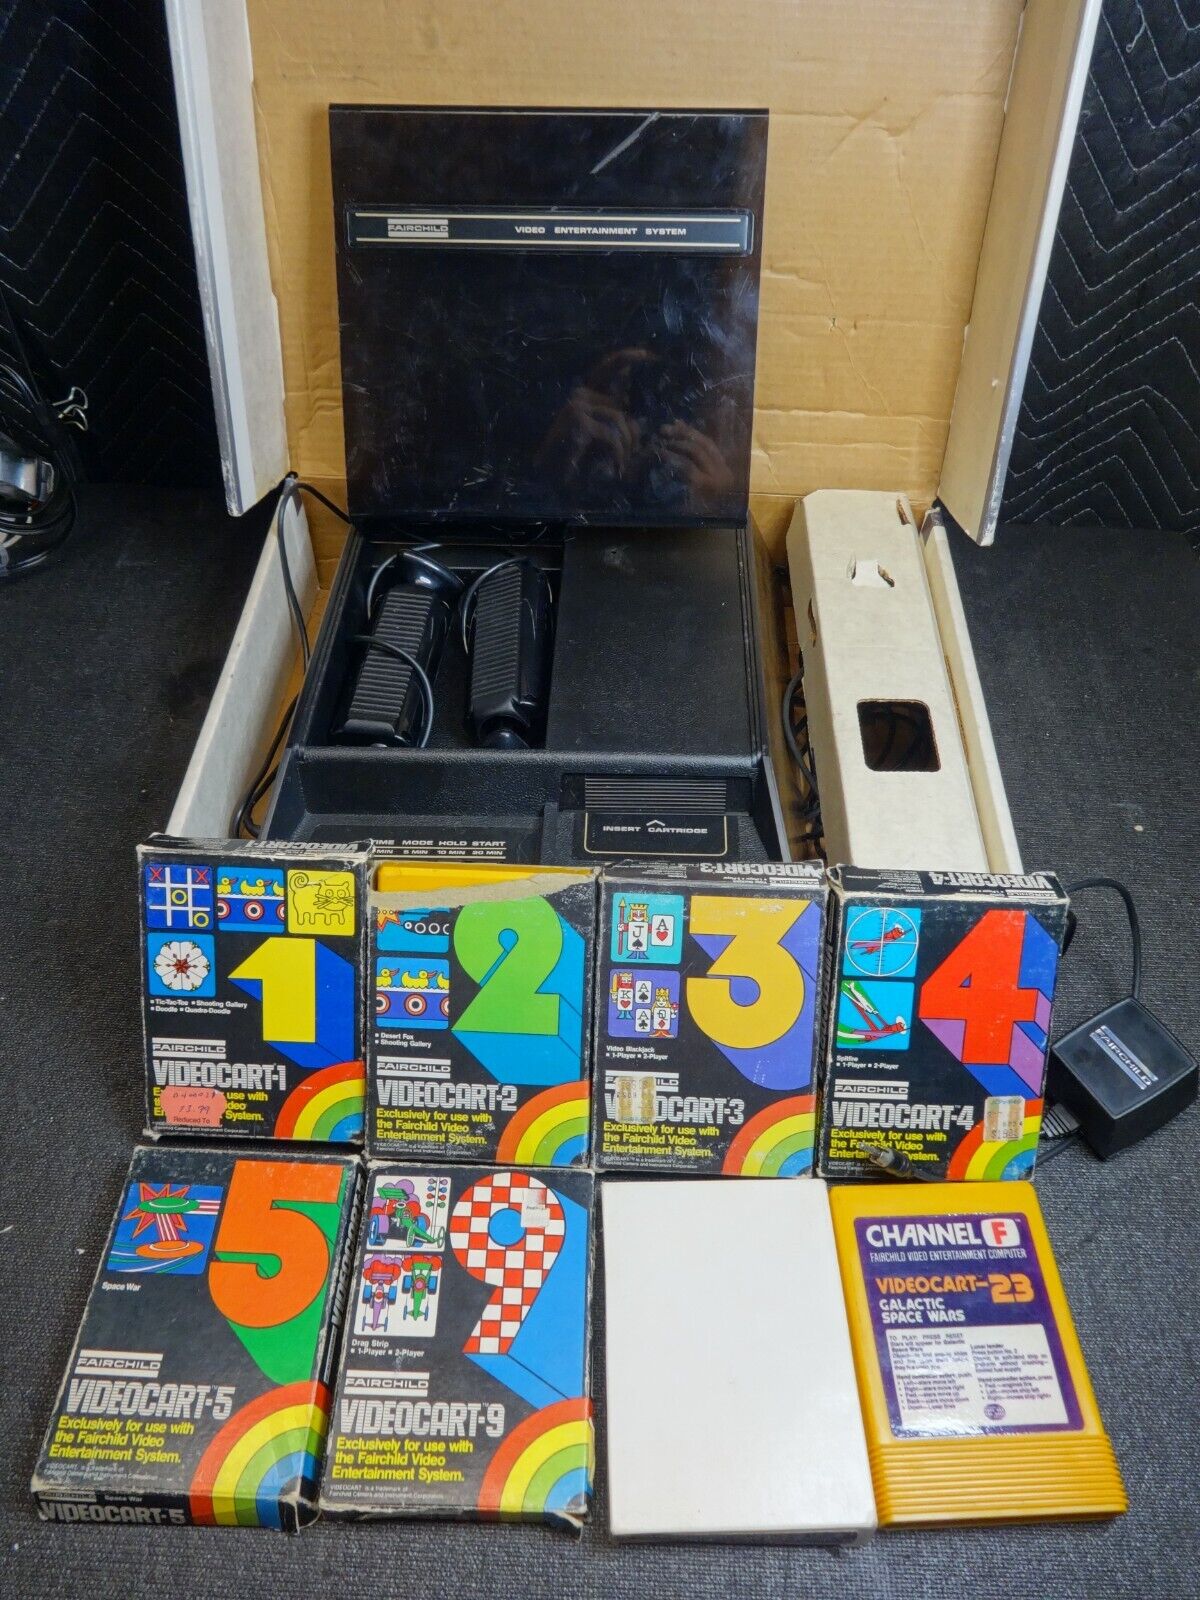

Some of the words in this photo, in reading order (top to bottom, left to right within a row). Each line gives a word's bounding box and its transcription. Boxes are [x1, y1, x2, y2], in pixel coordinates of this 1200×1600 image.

[514, 226, 546, 235] VIDEO
[554, 226, 638, 236] ENTERTAINMENT
[645, 228, 687, 236] SYSTEM
[648, 826, 708, 834] CARTRIDGE
[929, 870, 1053, 889] VIDEOCART-4
[656, 918, 669, 930] A
[632, 925, 645, 938] J
[451, 896, 563, 1036] 2
[687, 895, 813, 1050] 3
[227, 937, 315, 1043] 1
[637, 983, 649, 992] A
[919, 909, 1039, 1065] 4
[620, 990, 632, 1000] K
[196, 1000, 224, 1008] Shooting
[638, 1010, 649, 1020] A
[656, 1010, 668, 1020] Q
[380, 1040, 408, 1048] Shooting
[626, 1046, 655, 1054] Blackjack
[612, 1052, 636, 1060] 1-Player
[643, 1052, 668, 1060] 2-Player
[836, 1054, 858, 1062] Spitfire
[1094, 1028, 1152, 1086] FAIRCHILD
[874, 1062, 899, 1070] 2-Player
[152, 1059, 286, 1090] VIDEOCART-1
[226, 1092, 246, 1100] use
[248, 1092, 268, 1101] with
[376, 1079, 518, 1112] VIDEOCART-2
[226, 1102, 247, 1110] deo
[604, 1092, 745, 1124] VOCART-3
[226, 1110, 264, 1122] System.
[376, 1108, 431, 1122] Exclusively
[433, 1110, 448, 1120] for
[450, 1114, 469, 1122] use
[472, 1112, 492, 1123] with
[832, 1100, 974, 1130] VIDEOCART-4
[376, 1120, 393, 1130] the
[395, 1120, 438, 1131] Fairchild
[441, 1122, 470, 1132] Video
[604, 1122, 658, 1135] Exclusively
[660, 1124, 676, 1134] for
[678, 1127, 696, 1135] use
[698, 1126, 720, 1136] with
[376, 1130, 446, 1142] Entertainment
[448, 1134, 488, 1145] System.
[604, 1132, 620, 1142] the
[622, 1134, 665, 1144] Fairchild
[668, 1136, 696, 1146] Video
[830, 1128, 886, 1140] Exclusively
[888, 1130, 902, 1140] for
[926, 1132, 946, 1142] with
[602, 1142, 672, 1155] Entertainment
[675, 1146, 714, 1158] System.
[830, 1139, 847, 1148] the
[895, 1141, 924, 1150] Video
[866, 1222, 982, 1247] CHANNEL
[990, 1221, 1008, 1245] F
[208, 1160, 344, 1328] 5
[870, 1252, 906, 1262] FAIRCHILD
[907, 1250, 928, 1262] VIDEO
[930, 1250, 987, 1262] ENTERTAINMENT
[988, 1248, 1027, 1260] COMPUTER
[450, 1172, 566, 1354] 9
[102, 1281, 125, 1292] Space
[126, 1282, 142, 1292] War
[875, 1272, 1035, 1304] VIDEOCART-23
[879, 1298, 945, 1311] GALACTIC
[881, 1310, 924, 1324] SPACE
[928, 1310, 966, 1322] WARS
[352, 1339, 370, 1349] Drag
[372, 1340, 390, 1349] Strip
[358, 1348, 386, 1357] 1-Player
[394, 1349, 424, 1358] 2-Player
[77, 1358, 162, 1370] FAIRCHILD
[344, 1378, 429, 1389] FAIRCHILD
[66, 1378, 236, 1420] VIDEOCART-5
[340, 1398, 506, 1438] VIDEOCART-9
[58, 1416, 122, 1432] Exclusively
[125, 1419, 144, 1430] for
[145, 1422, 166, 1432] use
[170, 1422, 194, 1435] with
[54, 1430, 74, 1444] the
[76, 1432, 128, 1446] Fairchild
[130, 1435, 164, 1448] Video
[336, 1436, 401, 1454] Exclusively
[404, 1438, 422, 1450] for
[424, 1442, 446, 1452] use
[449, 1440, 474, 1453] with
[49, 1444, 134, 1460] Entertainment
[136, 1448, 181, 1464] System.
[335, 1452, 354, 1464] the
[357, 1452, 408, 1466] Fairchild
[410, 1454, 446, 1466] Video
[332, 1466, 415, 1480] Entertainment
[418, 1468, 464, 1483] System.
[39, 1501, 186, 1524] VIDEOCART-5
